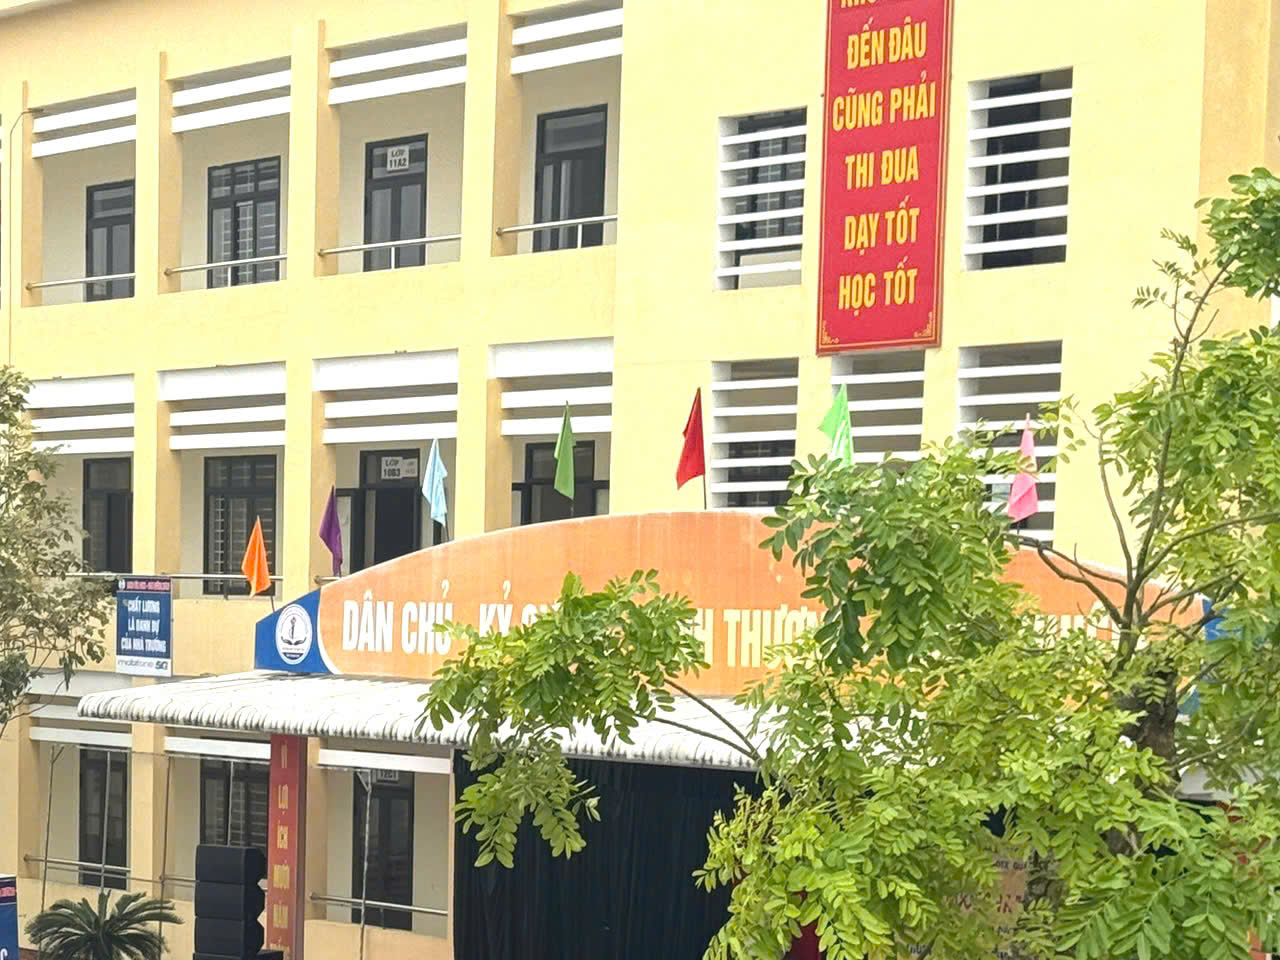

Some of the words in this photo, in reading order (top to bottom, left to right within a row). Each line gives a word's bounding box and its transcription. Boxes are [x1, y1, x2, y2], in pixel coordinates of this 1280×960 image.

[847, 16, 885, 69] ĐẾN
[888, 15, 927, 63] ĐÂU
[832, 87, 883, 132] CŨNG
[890, 71, 936, 124] PHẢI
[845, 151, 875, 190] THI
[880, 146, 919, 186] ĐUA
[844, 212, 880, 256] DẠY
[885, 195, 920, 246] TỐT
[838, 271, 876, 317] HỌC
[883, 255, 918, 306] TỐT
[342, 589, 394, 654] DÂN
[401, 579, 452, 655] CHỦ
[723, 603, 826, 670] THƯƠ
[155, 661, 168, 670] 5G
